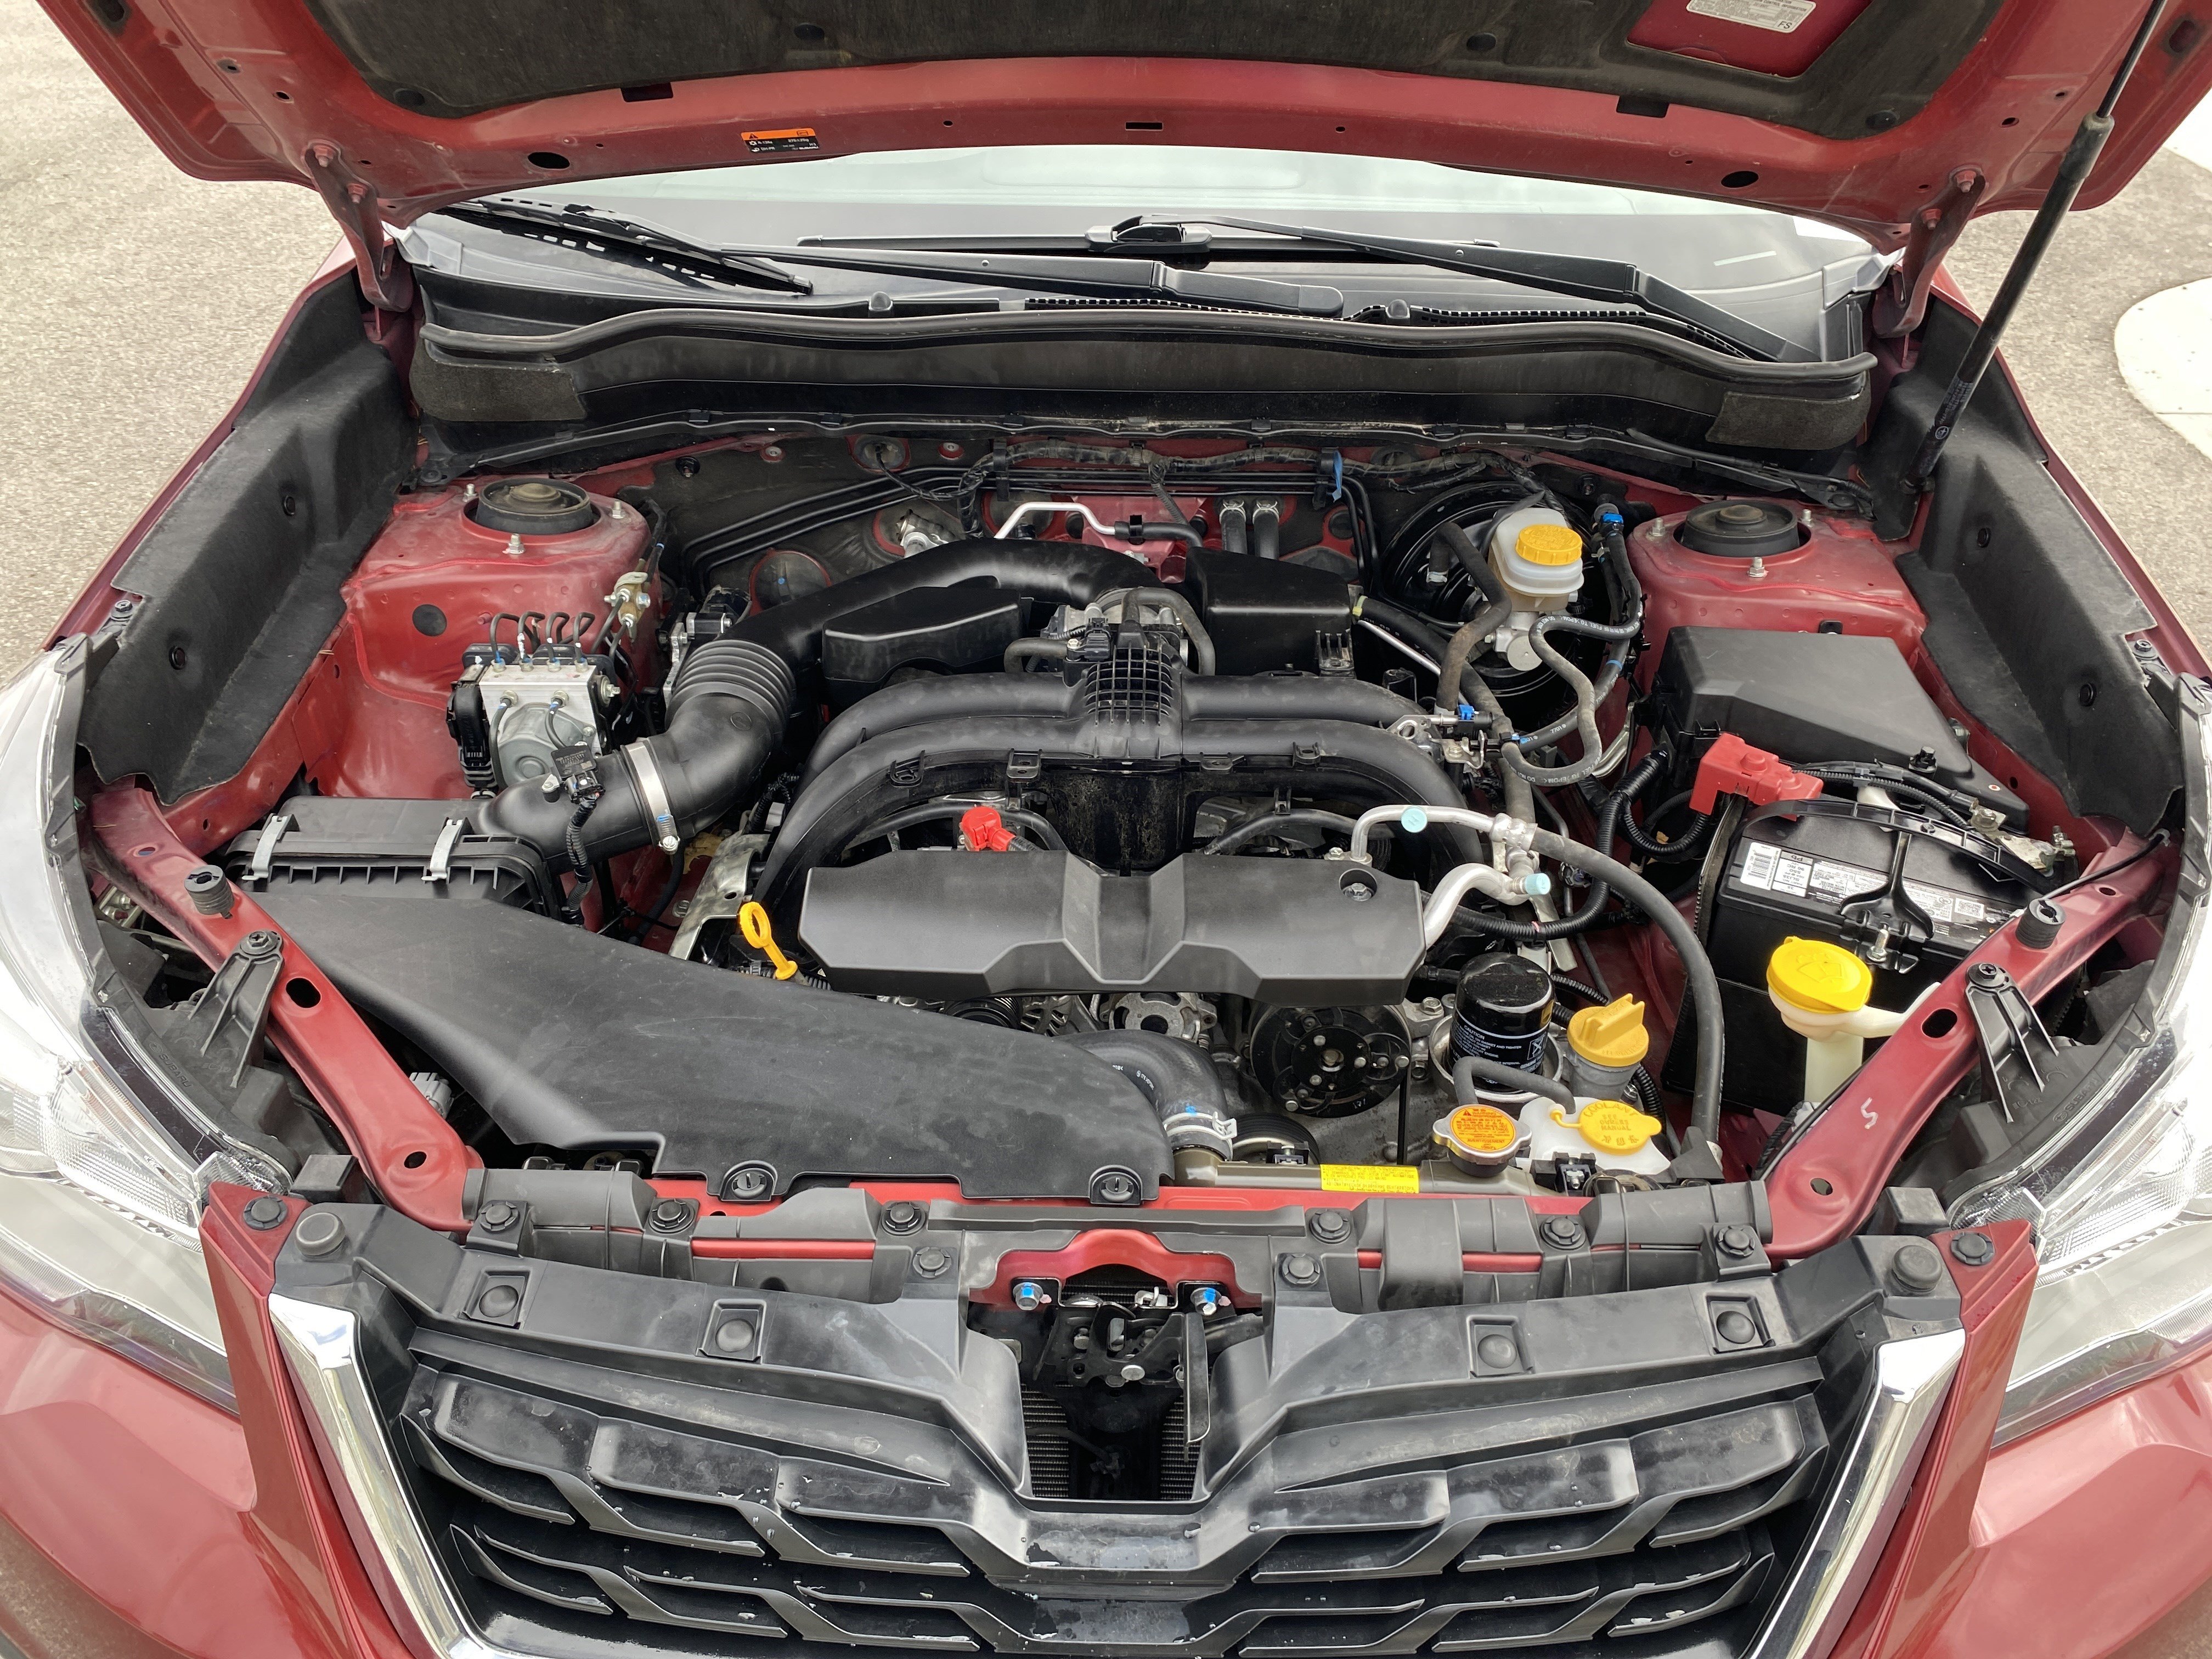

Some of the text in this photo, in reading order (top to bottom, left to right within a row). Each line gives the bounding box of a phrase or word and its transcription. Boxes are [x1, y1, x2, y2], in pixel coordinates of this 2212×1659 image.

[1778, 21, 1792, 30] FS
[1590, 622, 1602, 630] FUEL
[1550, 725, 1562, 734] 7701
[1464, 1025, 1485, 1040] CAUTION
[159, 1053, 192, 1087] SUBARU
[2063, 1077, 2099, 1112] SUBARU
[1584, 1102, 1638, 1118] COOLANT
